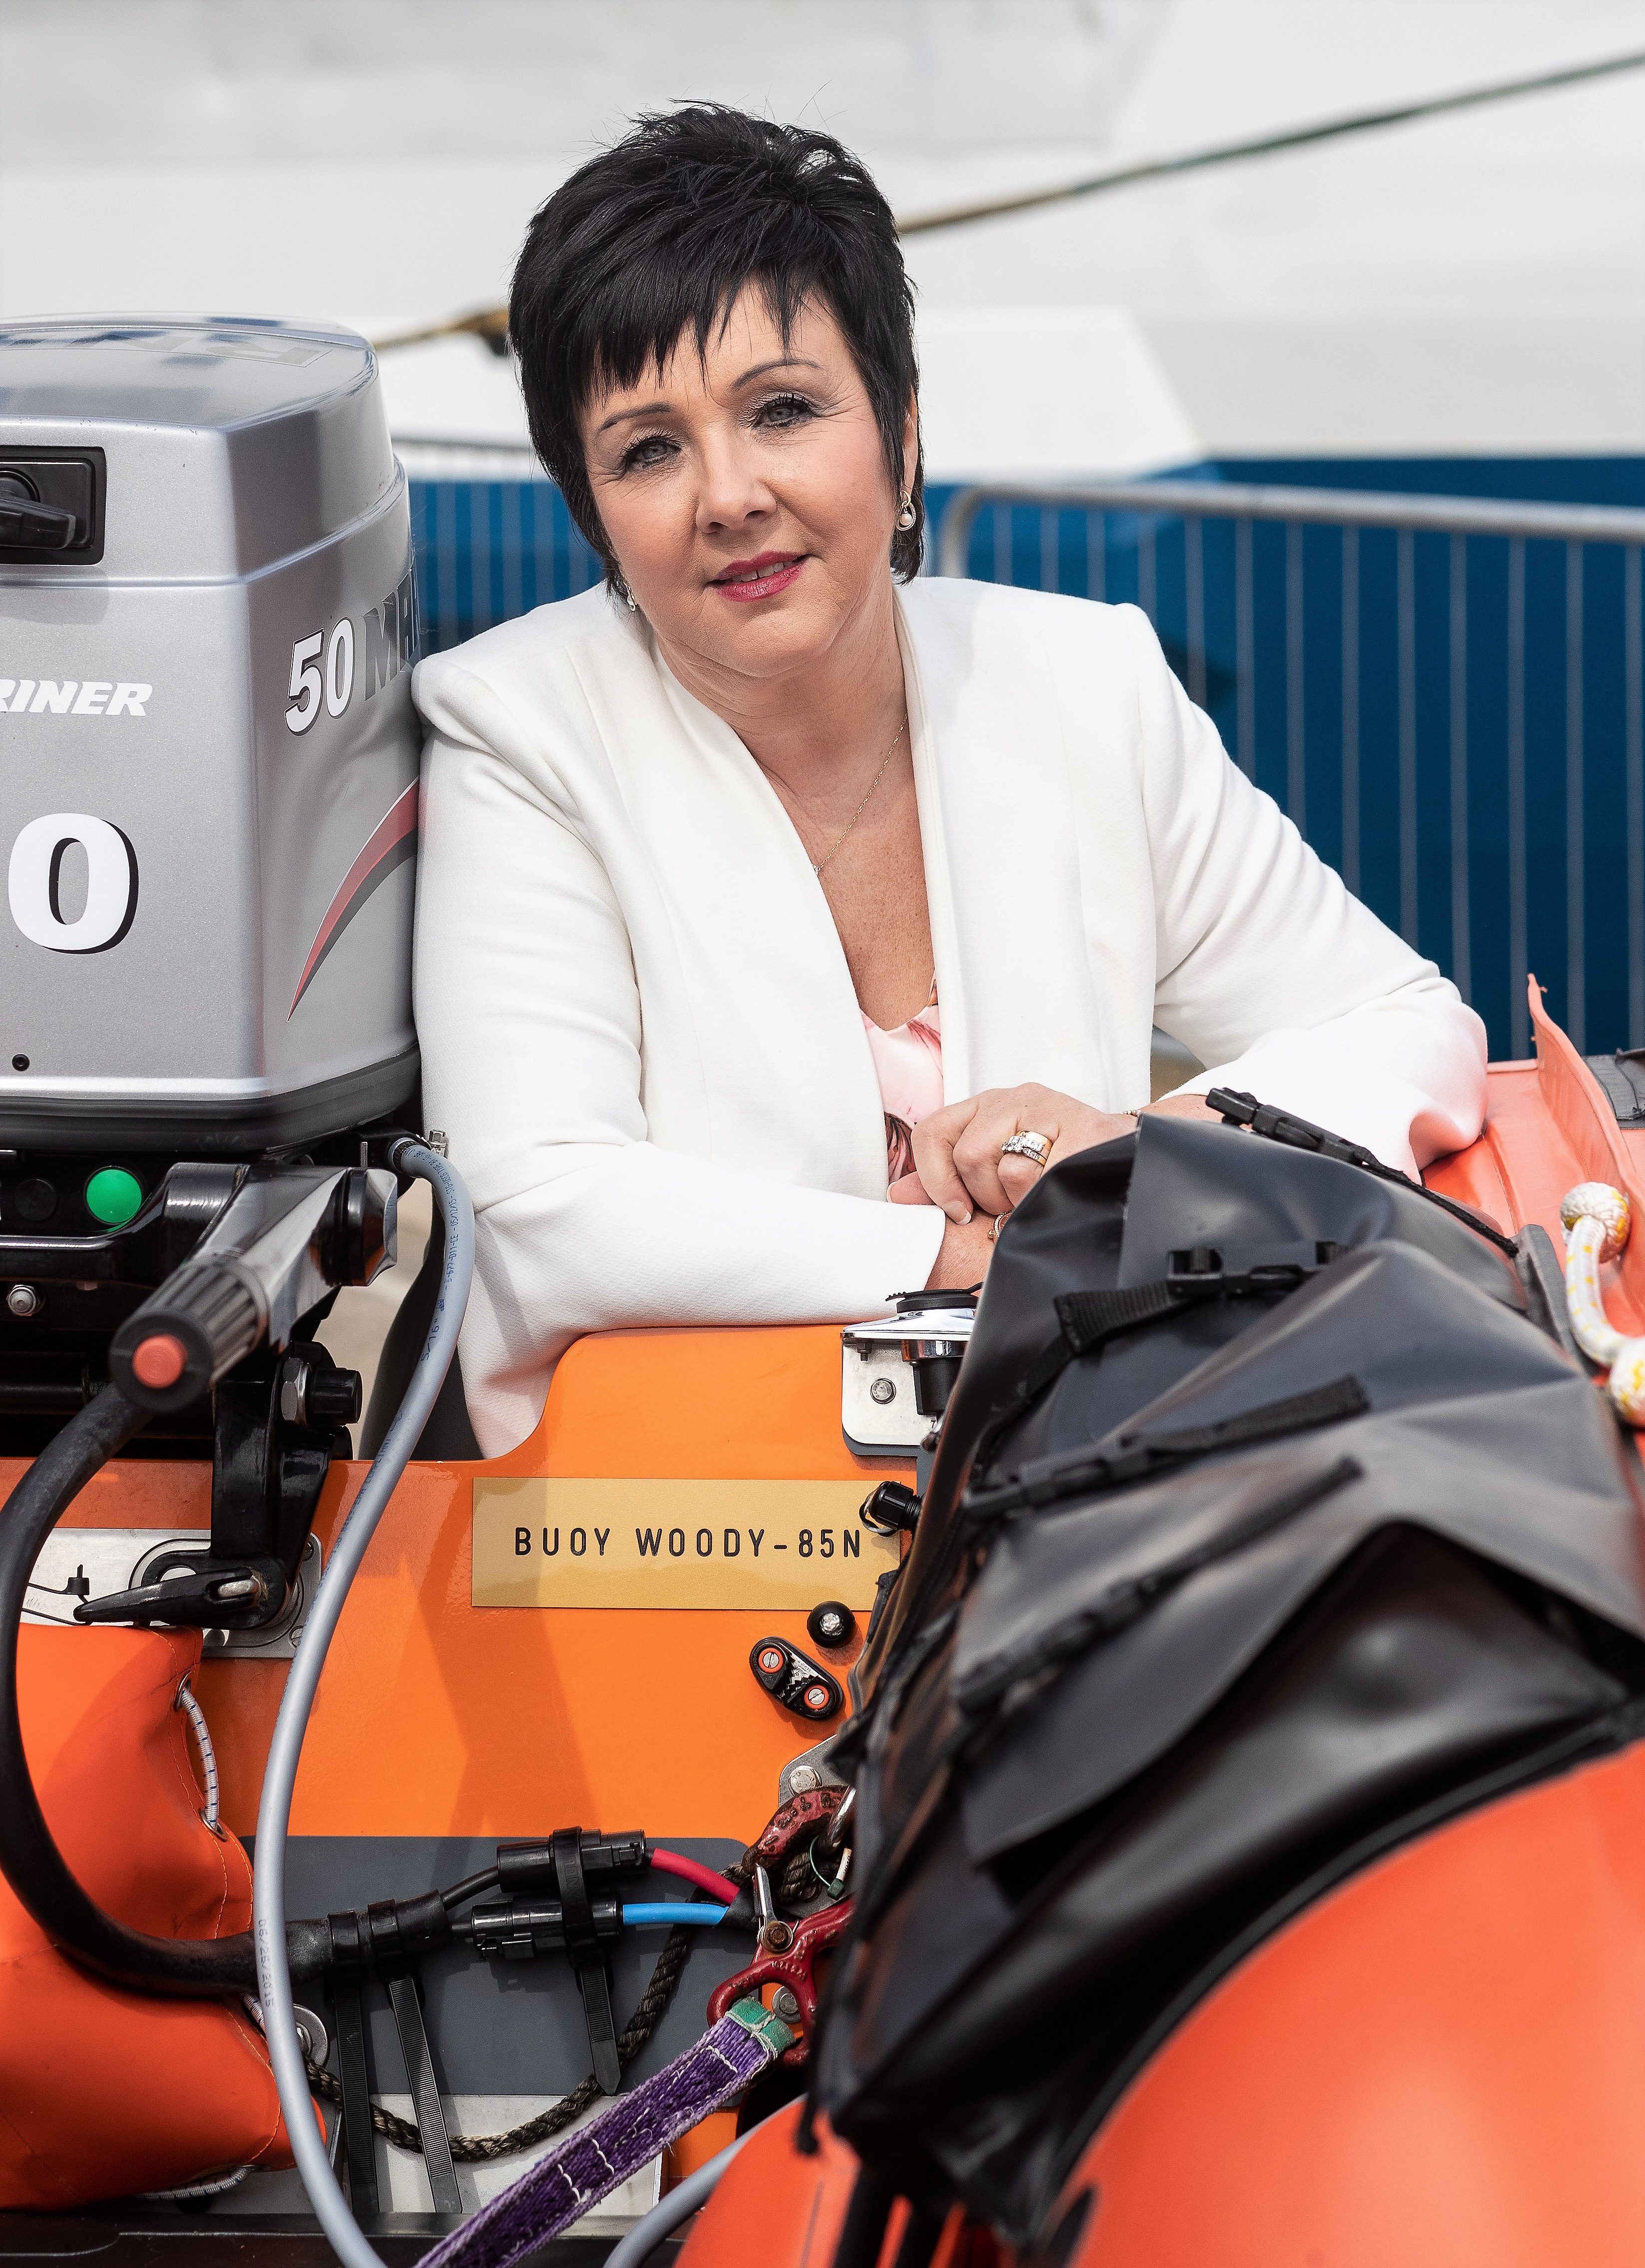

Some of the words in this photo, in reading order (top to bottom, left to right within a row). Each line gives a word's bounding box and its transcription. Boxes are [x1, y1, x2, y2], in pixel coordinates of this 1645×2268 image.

[284, 615, 355, 736] 50
[8, 813, 139, 955] 0
[433, 1163, 445, 1174] TYPE
[515, 1527, 610, 1556] BUOY
[635, 1528, 859, 1558] WOODY-85N
